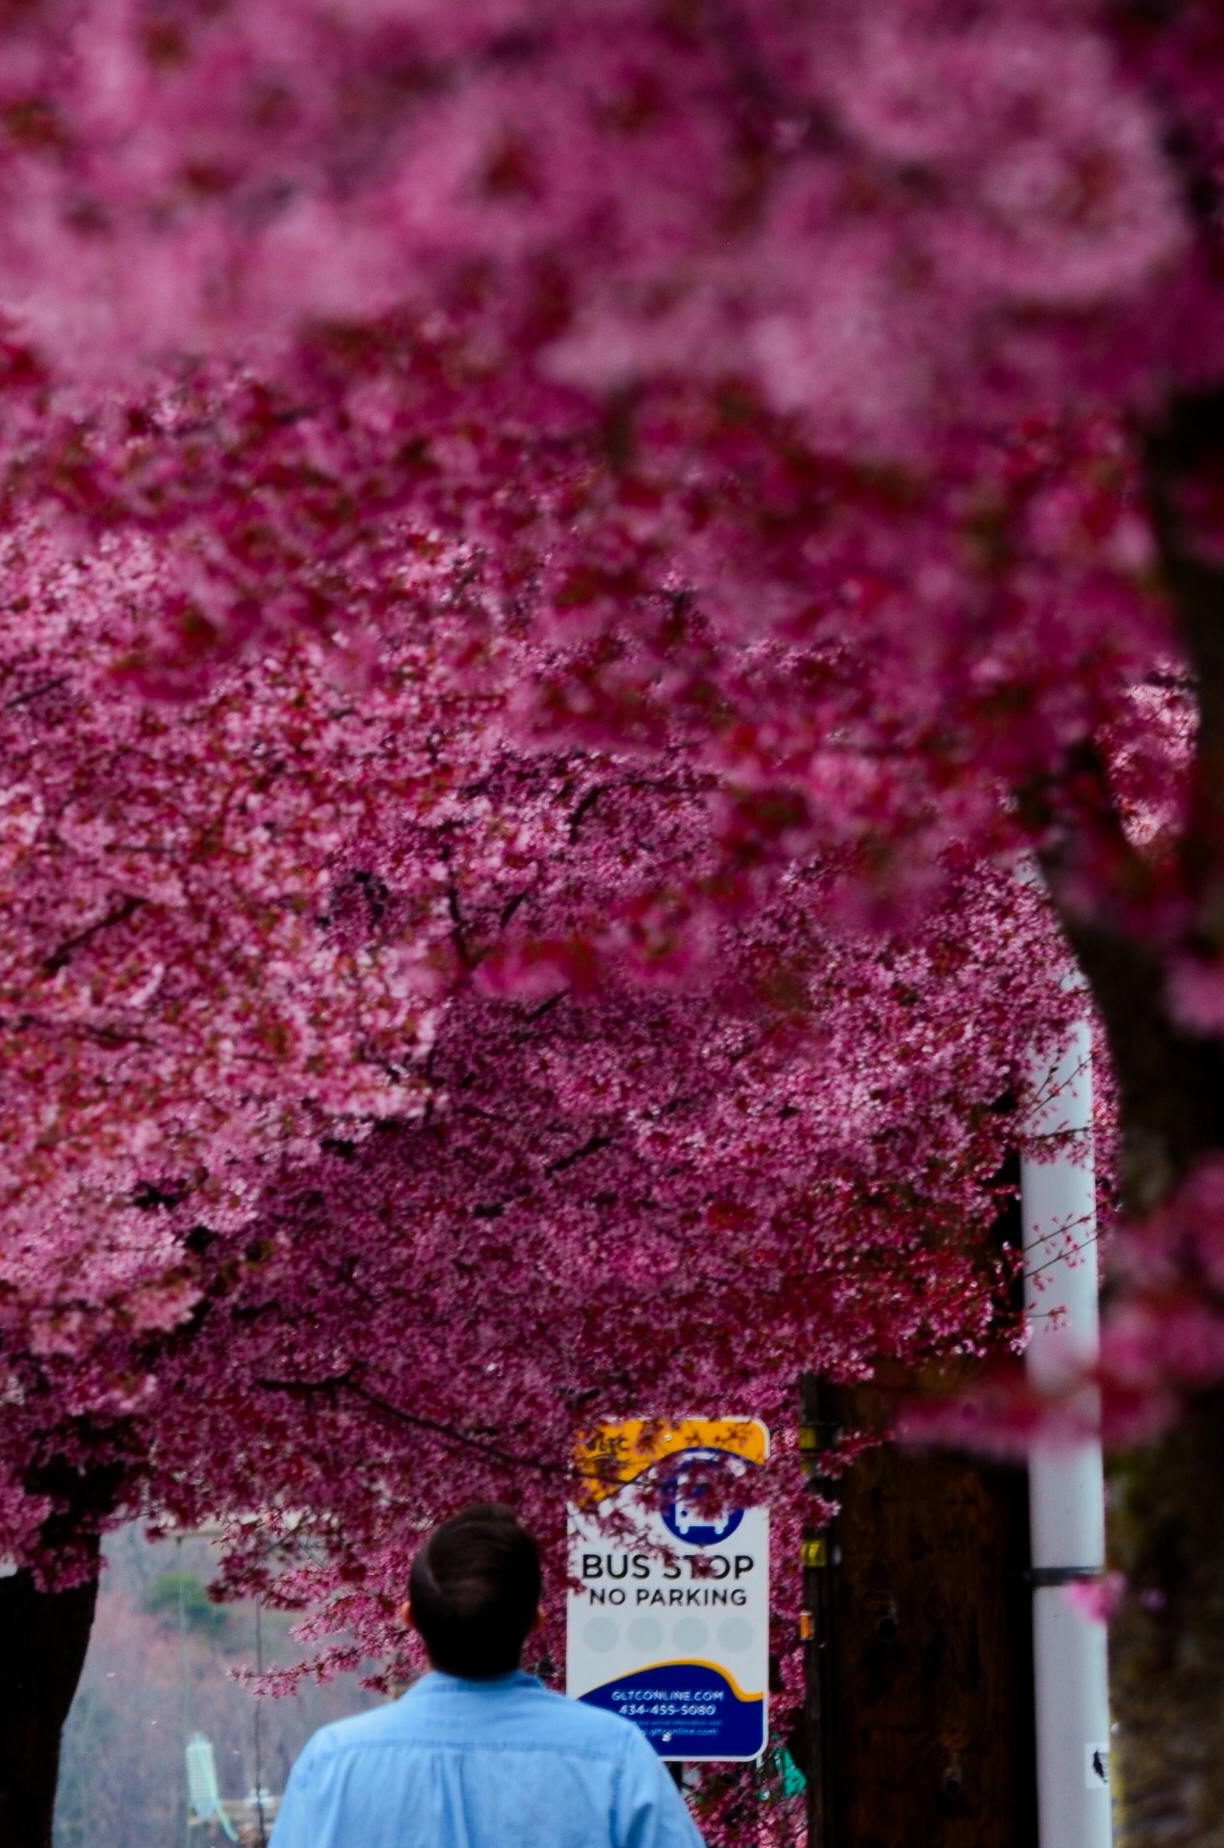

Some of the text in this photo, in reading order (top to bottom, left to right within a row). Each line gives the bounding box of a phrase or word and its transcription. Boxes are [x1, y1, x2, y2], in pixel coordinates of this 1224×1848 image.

[582, 1554, 651, 1580] BUS
[589, 1588, 748, 1607] NO PARKING
[611, 1690, 724, 1701] GLTCONLINE.COM
[618, 1704, 717, 1716] 434-455-5080
